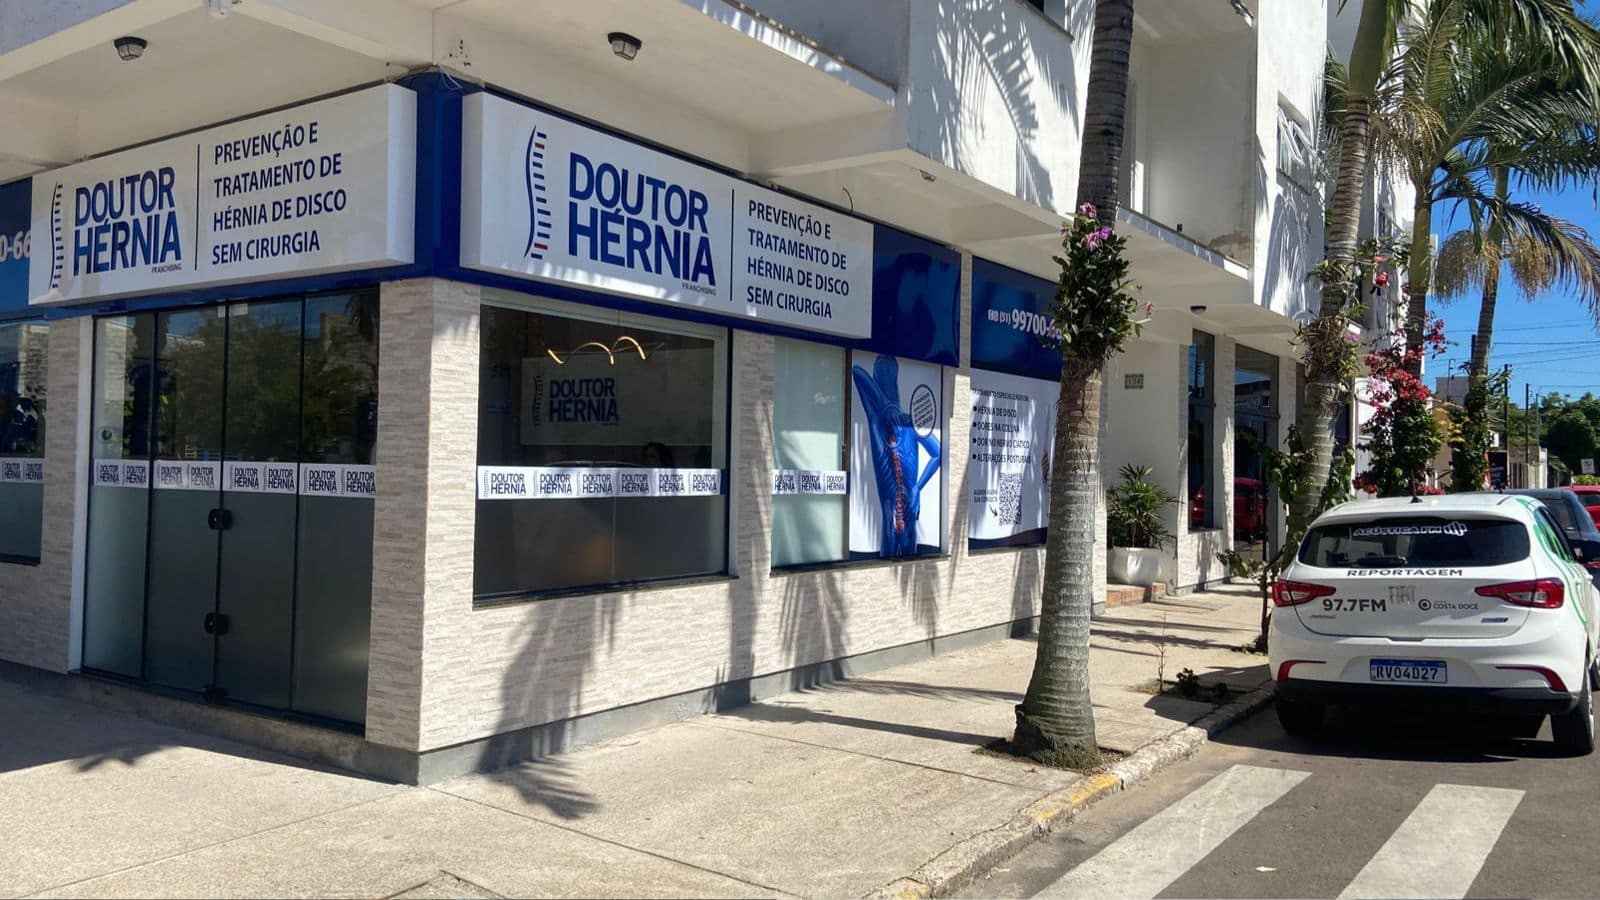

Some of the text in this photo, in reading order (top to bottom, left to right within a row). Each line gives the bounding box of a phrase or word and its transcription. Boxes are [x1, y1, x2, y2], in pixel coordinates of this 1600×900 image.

[214, 121, 318, 165] PREVENÇÃO E
[214, 152, 342, 199] TRATAMENTO DE
[74, 165, 175, 227] DOUTOR
[569, 151, 709, 234] DOUTOR
[213, 189, 347, 232] HÉRNIA DE DISCO
[748, 200, 831, 240] PREVENÇÃO E
[73, 210, 182, 277] HÉRNIA
[212, 230, 320, 265] SEM CIRURGIA
[568, 201, 717, 286] HÉRNIA
[748, 228, 847, 270] TRATAMENTO DE
[747, 256, 850, 296] HÉRNIA DE DISCO
[747, 285, 832, 319] SEM CIRURGIA
[549, 377, 616, 399] DOUTOR
[1003, 407, 1017, 418] DSCO
[191, 467, 213, 476] DOUTOR
[234, 467, 258, 477] DOUTOR
[268, 469, 293, 478] DOUTOR
[309, 470, 336, 479] DOUTOR
[346, 471, 375, 481] DOUTOR
[490, 473, 525, 483] DOUTOR
[540, 473, 571, 483] DOUTOR
[582, 473, 611, 483] DOUTOR
[622, 474, 648, 483] DOUTOR
[659, 474, 684, 483] DOUTOR
[692, 474, 717, 483] DOUTOR
[1347, 568, 1463, 577] REPORTAGEM
[1323, 598, 1387, 612] 97.7FM
[1433, 602, 1479, 610] COSTA DOCE
